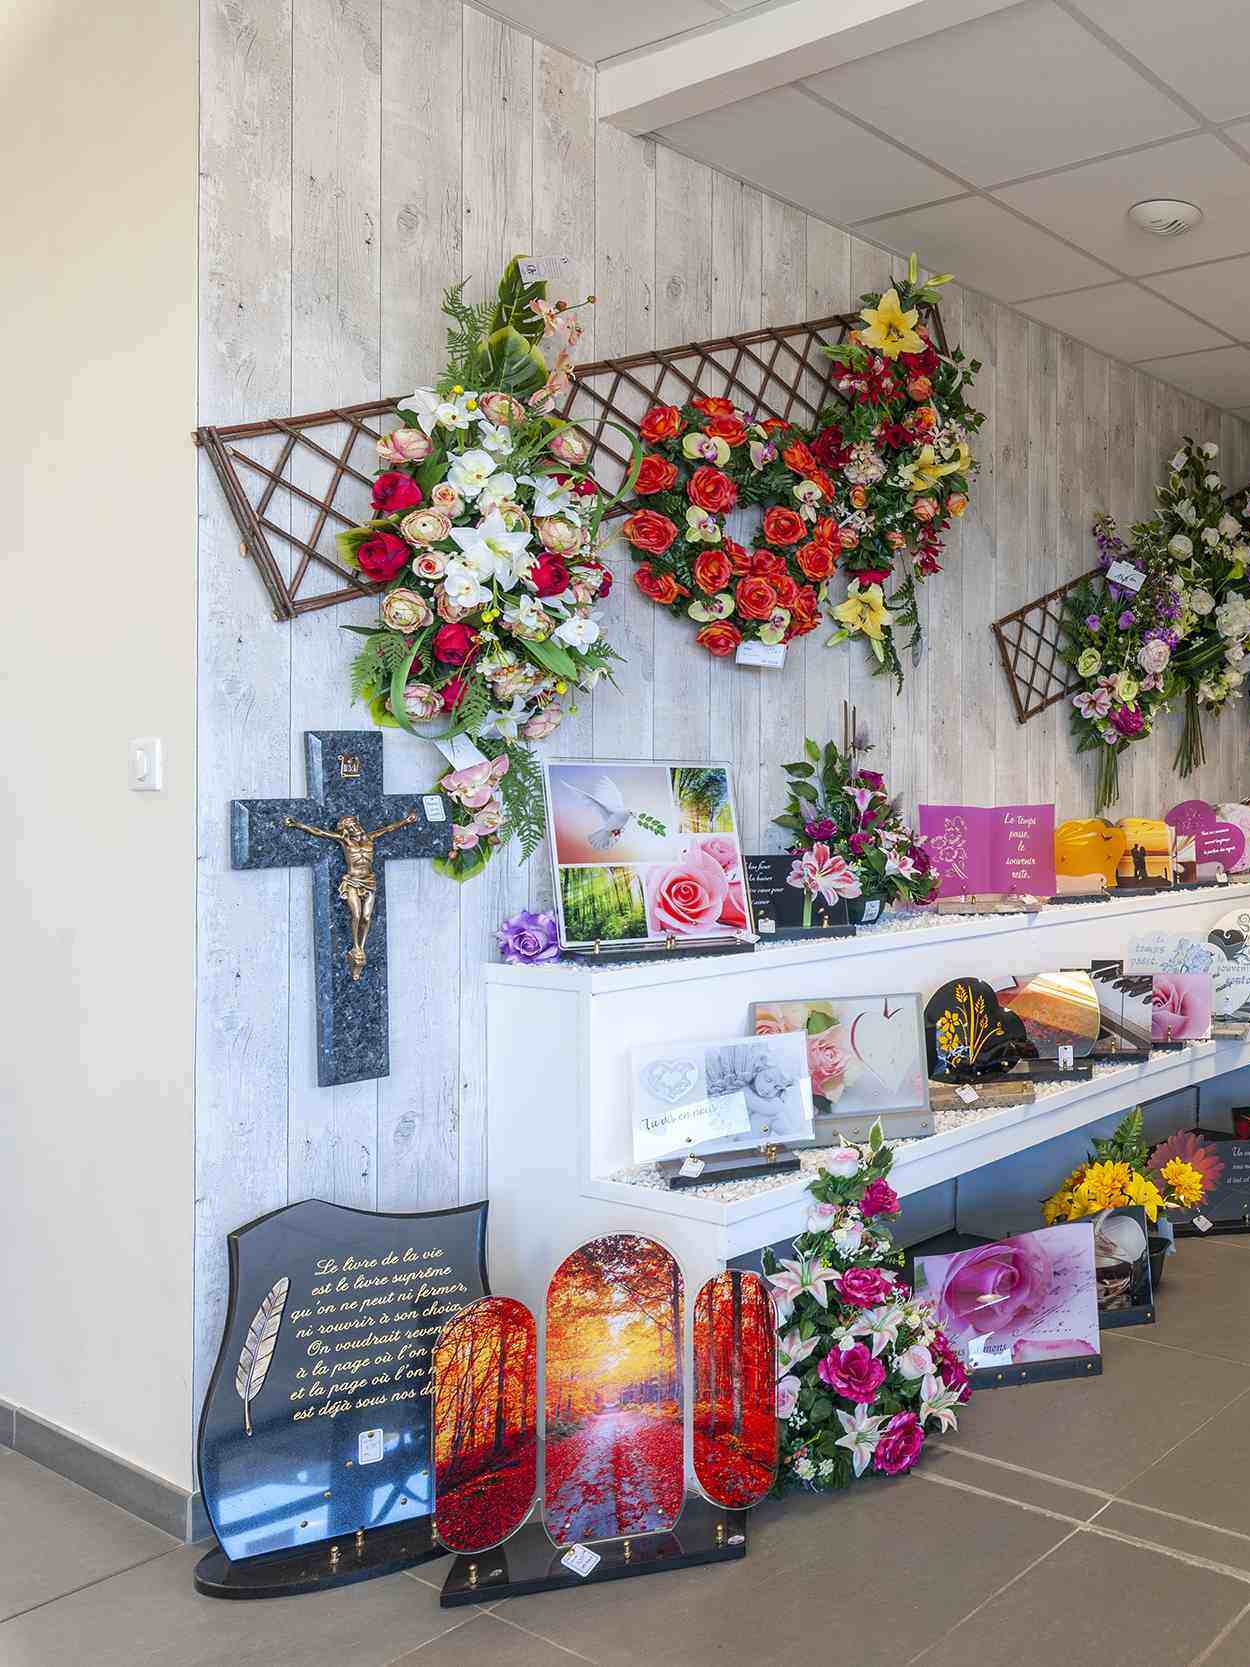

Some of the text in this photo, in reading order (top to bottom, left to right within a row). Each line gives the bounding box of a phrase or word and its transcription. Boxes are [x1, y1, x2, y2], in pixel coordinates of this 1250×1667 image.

[1018, 840, 1025, 851] le
[314, 1247, 445, 1275] Le livre de la vie
[311, 1266, 452, 1296] est le livre suprême
[290, 1282, 468, 1324] qu'on ne peut ni fermer,
[296, 1324, 314, 1339] ni
[317, 1315, 376, 1334] rouvrir
[379, 1312, 391, 1325] à
[393, 1309, 420, 1322] son
[306, 1339, 332, 1357] On
[334, 1329, 402, 1352] voudrait
[295, 1366, 308, 1379] à
[311, 1359, 330, 1377] la
[329, 1357, 371, 1378] page
[373, 1351, 394, 1365] où
[397, 1343, 429, 1361] l'on
[289, 1387, 306, 1401] et
[308, 1380, 327, 1397] la
[326, 1378, 369, 1399] page
[371, 1372, 392, 1386] où
[394, 1363, 426, 1381] l'on
[293, 1405, 316, 1421] est
[318, 1399, 353, 1418] déjà
[355, 1394, 388, 1409] sous
[391, 1388, 417, 1403] nos
